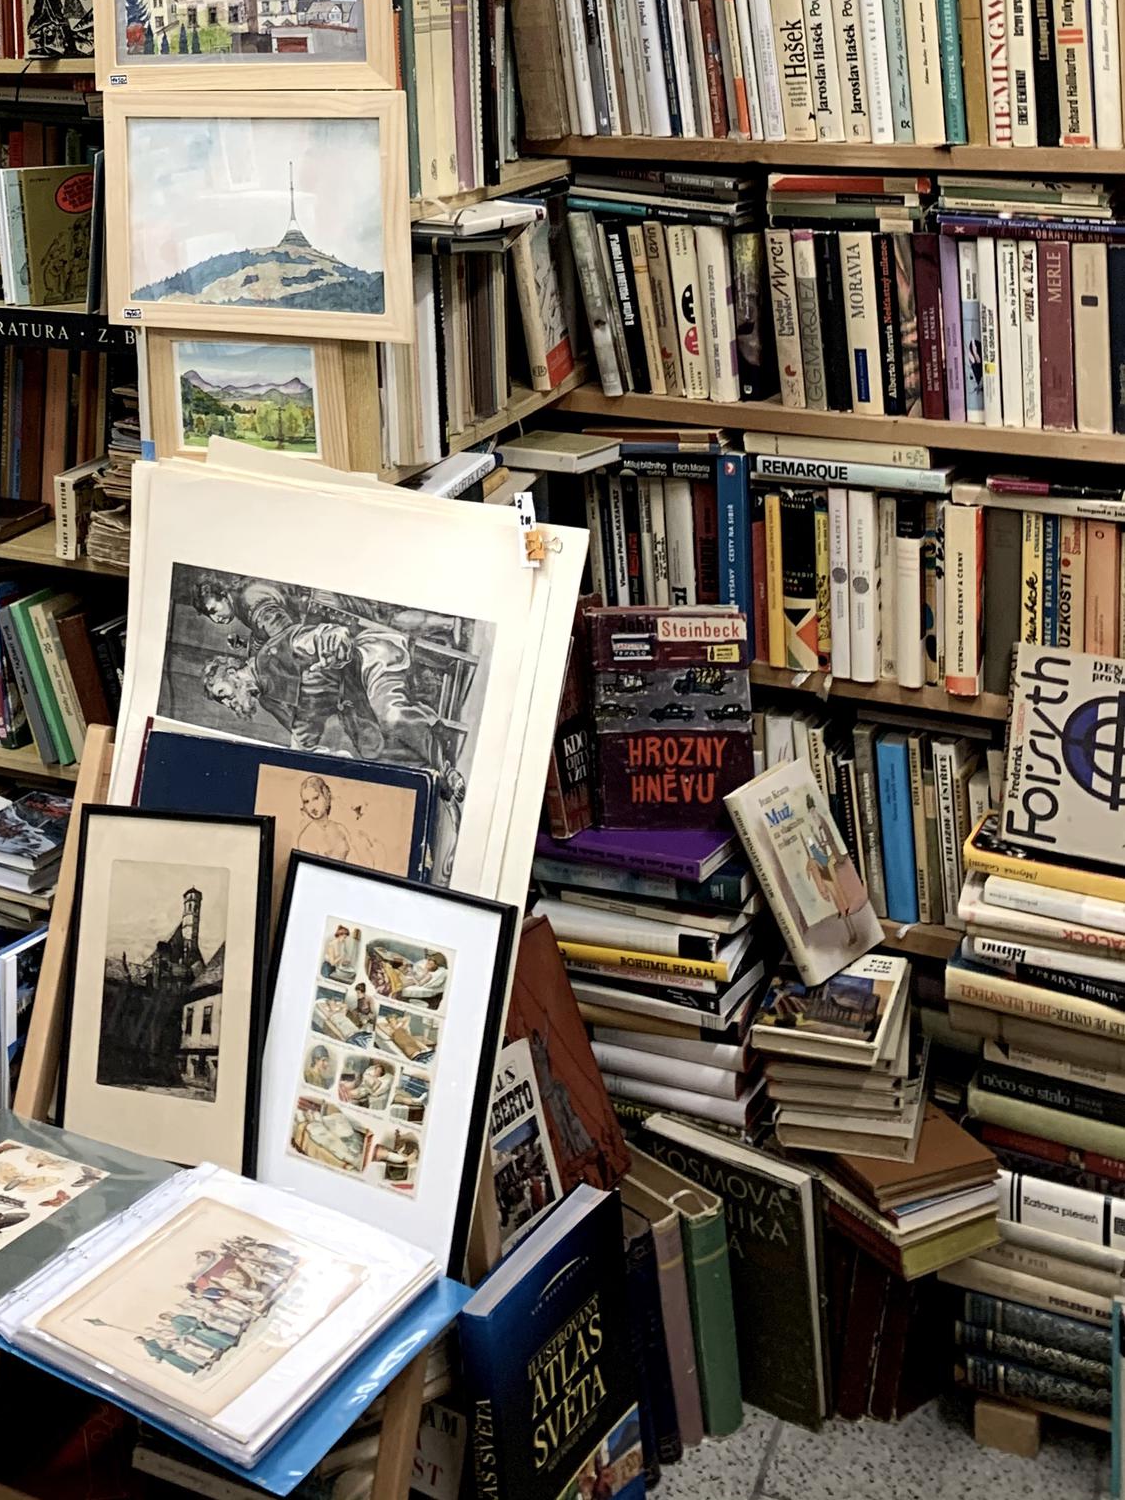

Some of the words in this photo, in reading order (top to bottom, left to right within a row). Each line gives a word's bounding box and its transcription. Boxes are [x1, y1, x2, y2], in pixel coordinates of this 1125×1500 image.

[1062, 0, 1075, 28] Toulky
[779, 19, 807, 79] Hašek
[811, 23, 825, 59] Hašek
[843, 24, 858, 62] Hašek
[813, 62, 833, 114] Jaroslav
[847, 65, 866, 116] Jaroslav
[1067, 100, 1080, 134] Richard
[880, 239, 889, 276] milenec
[846, 243, 865, 319] MORAVIA
[1047, 252, 1062, 303] MERLE
[886, 325, 896, 362] Moravia
[888, 363, 897, 398] Alberto
[763, 459, 848, 480] REMARQUE
[956, 587, 964, 626] ČERVENÝ
[661, 620, 741, 638] Steinbeck
[627, 736, 729, 768] HROZNY
[631, 764, 718, 804] HNĚVU
[1008, 744, 1024, 800] Frederick
[764, 803, 794, 828] Muž
[620, 956, 671, 973] BOHUMIL
[672, 964, 717, 980] HRABAL
[982, 1074, 1014, 1096] něco
[1017, 1084, 1034, 1098] se
[1036, 1086, 1070, 1106] stalo
[1022, 1195, 1060, 1214] Katova
[1066, 1206, 1098, 1225] pieseň
[531, 1314, 604, 1420] ATLAS
[533, 1364, 608, 1469] SVĚTA
